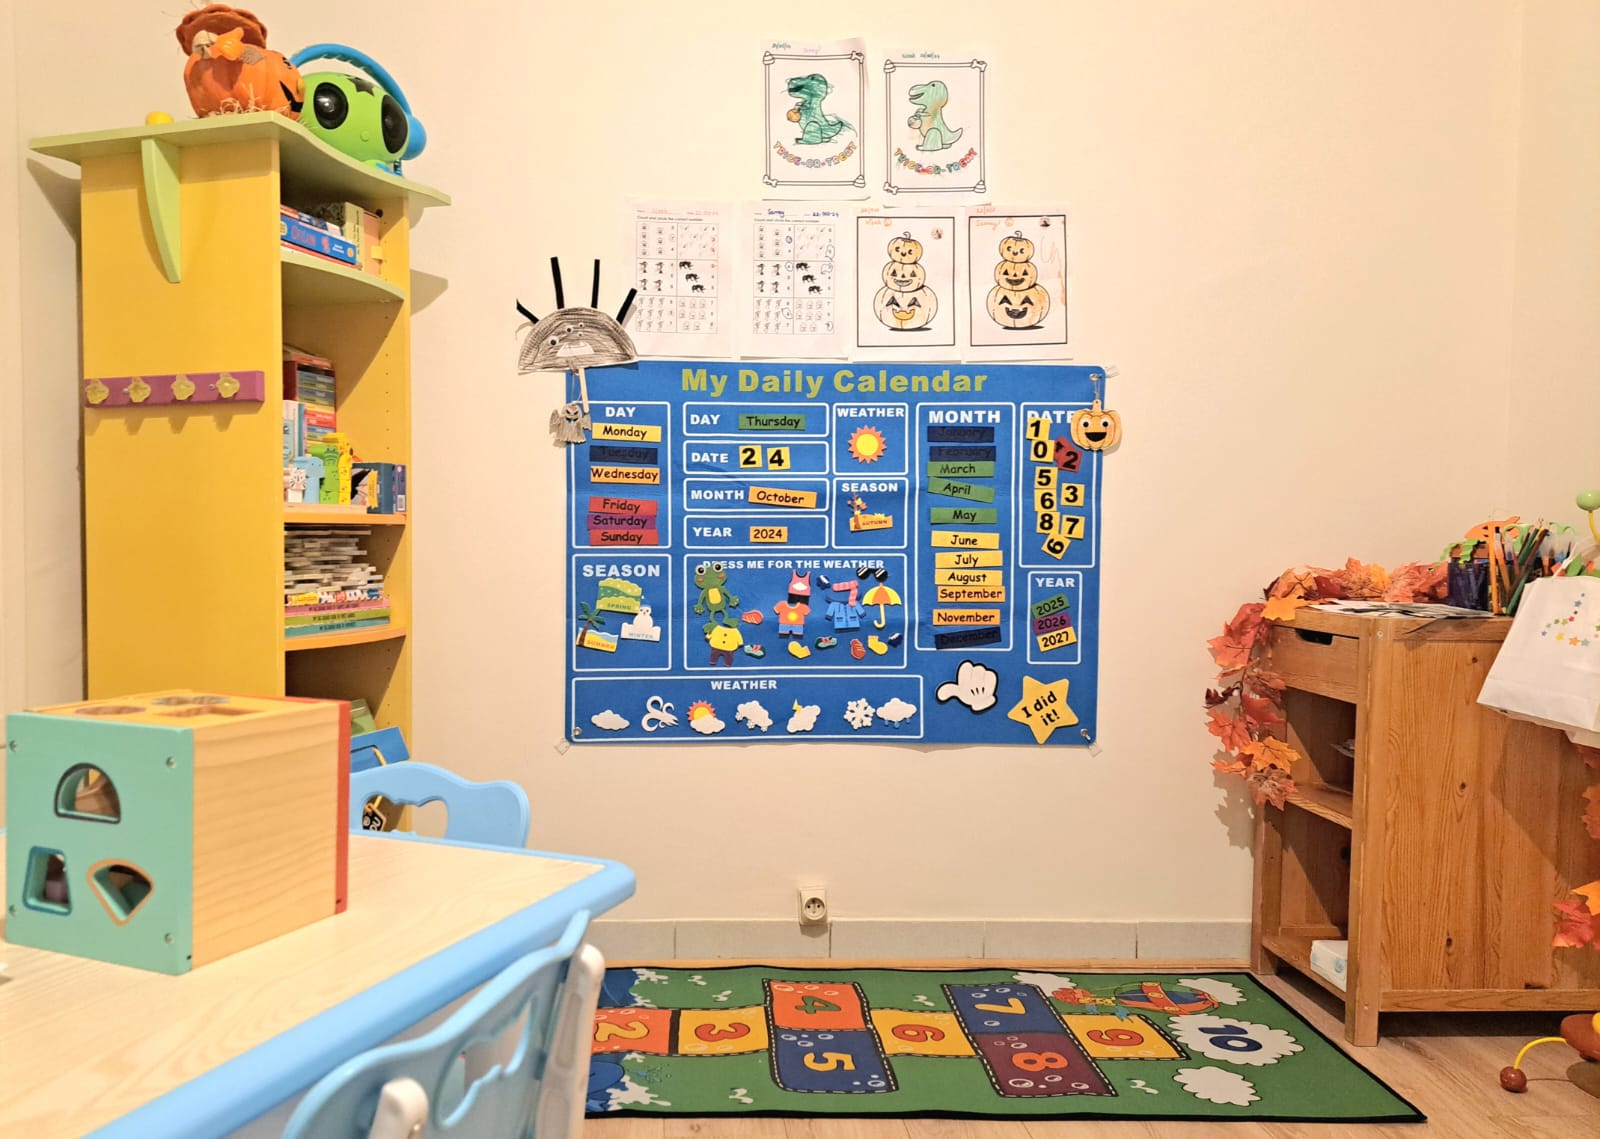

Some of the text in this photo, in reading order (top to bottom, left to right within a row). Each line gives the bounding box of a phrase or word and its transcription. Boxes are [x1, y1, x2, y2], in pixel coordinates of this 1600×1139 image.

[681, 368, 988, 398] My Daily Calendar
[605, 406, 636, 418] DAY
[837, 407, 905, 418] WEATHER
[928, 410, 1001, 424] MONTH
[689, 414, 801, 429] DAY Thursday
[1029, 419, 1041, 438] 1
[602, 425, 648, 441] Monday
[690, 447, 784, 467] DATE 2 4
[1033, 440, 1048, 459] 0
[1062, 451, 1079, 470] 2
[591, 467, 659, 482] Wednesday
[939, 463, 976, 475] March
[1037, 468, 1051, 486] 5
[841, 482, 898, 492] SEASON
[943, 482, 971, 496] April
[690, 489, 805, 505] MONTH October
[1040, 485, 1078, 510] 6 3
[602, 498, 641, 514] Friday
[593, 514, 648, 529] Saturday
[952, 509, 977, 523] May
[1039, 513, 1080, 535] 8 7
[600, 530, 643, 544] Sunday
[692, 527, 782, 540] YEAR 2024
[950, 534, 978, 546] June
[702, 560, 885, 569] DESS ME FOR THE WEATHER
[954, 553, 979, 567] July
[582, 563, 661, 578] SEASON
[947, 573, 987, 585] August
[1035, 577, 1075, 588] YEAR
[940, 588, 1002, 602] September
[1035, 597, 1065, 615] 2025
[937, 612, 995, 623] November
[1037, 616, 1067, 630] 2026
[1041, 631, 1070, 648] 2027
[711, 679, 778, 690] WEATHER
[1021, 690, 1058, 718] I did
[1041, 709, 1060, 726] it!
[795, 995, 842, 1015] 4
[974, 997, 1027, 1015] 7
[694, 1021, 751, 1043] 3
[1197, 1024, 1264, 1053] 10
[802, 1051, 856, 1072] 5
[1011, 1051, 1070, 1073] 8
